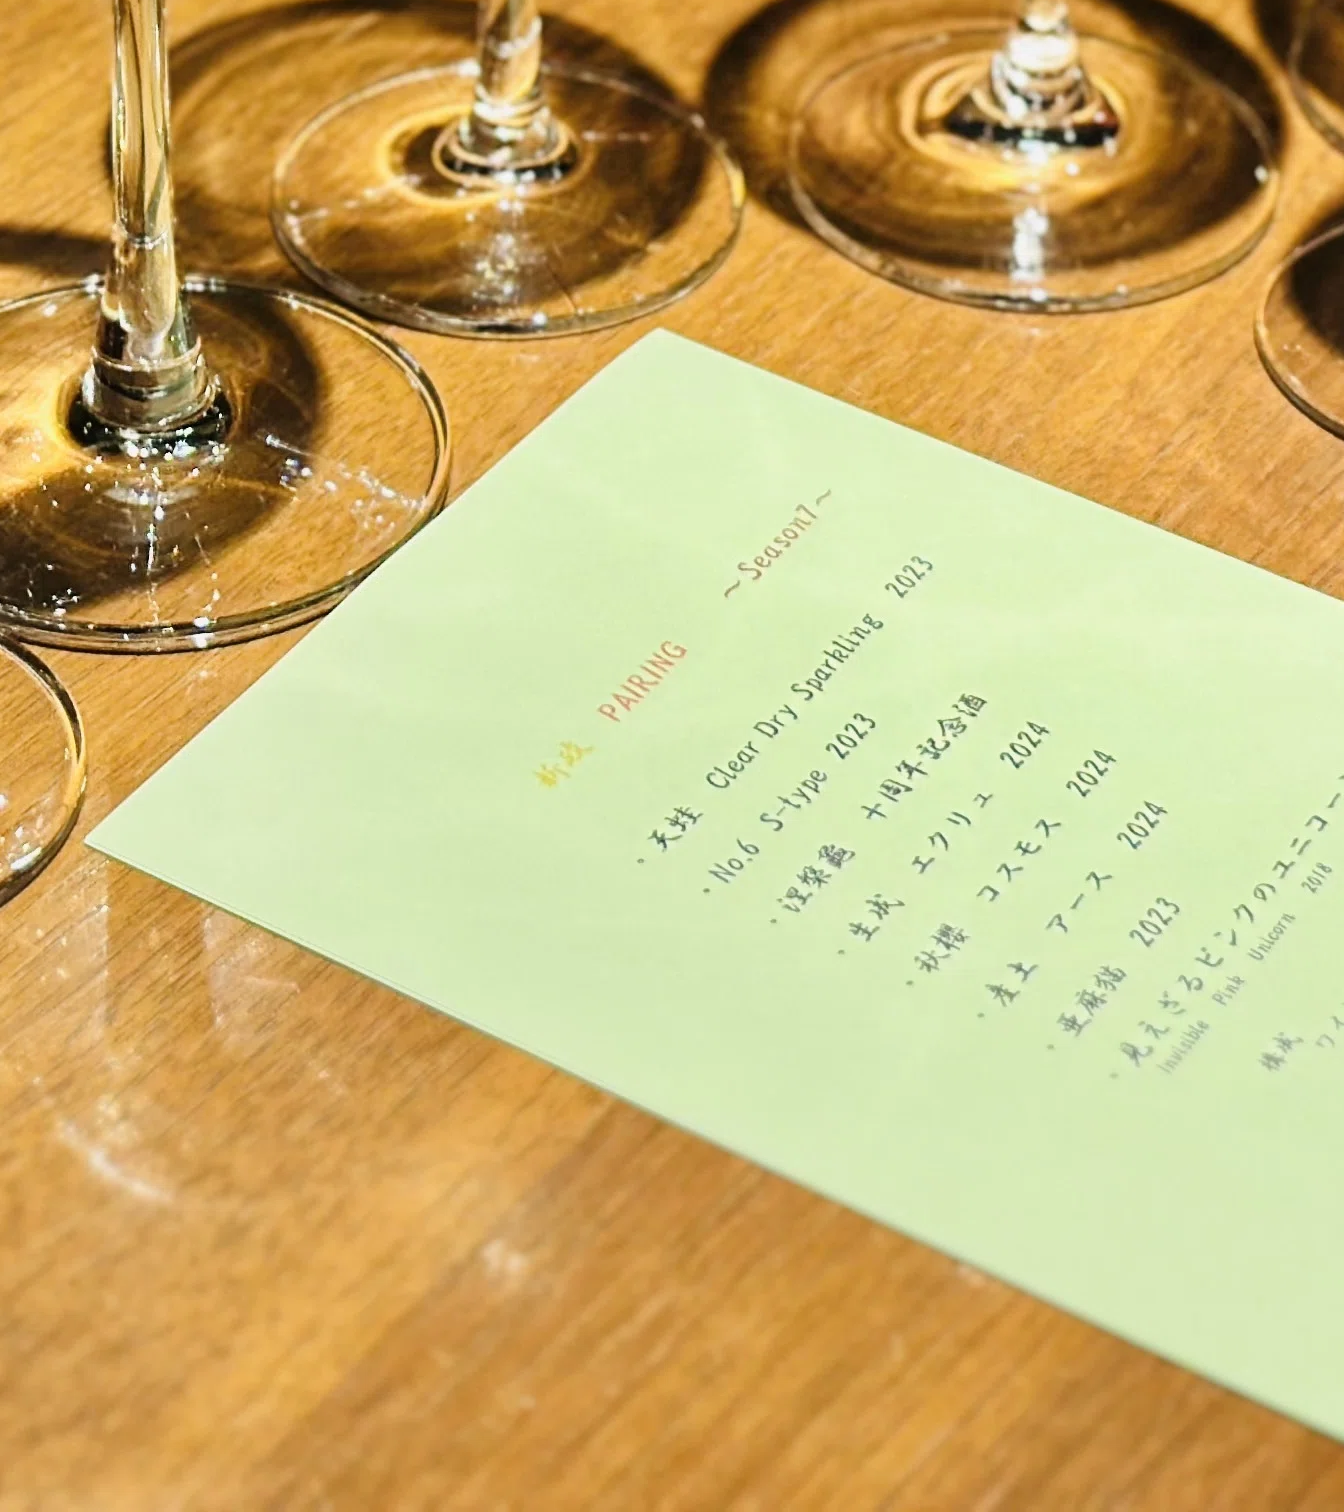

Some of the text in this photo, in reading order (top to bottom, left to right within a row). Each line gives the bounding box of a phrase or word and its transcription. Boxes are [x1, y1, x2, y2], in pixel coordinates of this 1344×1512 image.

[595, 638, 689, 723] PAIRING
[645, 553, 935, 852] 天蛙 Clear Dry Sparkling 2023
[858, 691, 989, 821] 十周年記念酒
[706, 710, 877, 885] No.6 S-type 2023
[847, 719, 1051, 943] 生成 エクリュ 2024
[974, 816, 1063, 903] コスモス
[1063, 747, 1118, 799] 2024
[1043, 869, 1114, 935] アース
[1114, 798, 1169, 851] 2024
[1054, 895, 1182, 1038] 亜麻猫 2023
[1153, 860, 1334, 1075] Invisible Pink Unicorn 2018
